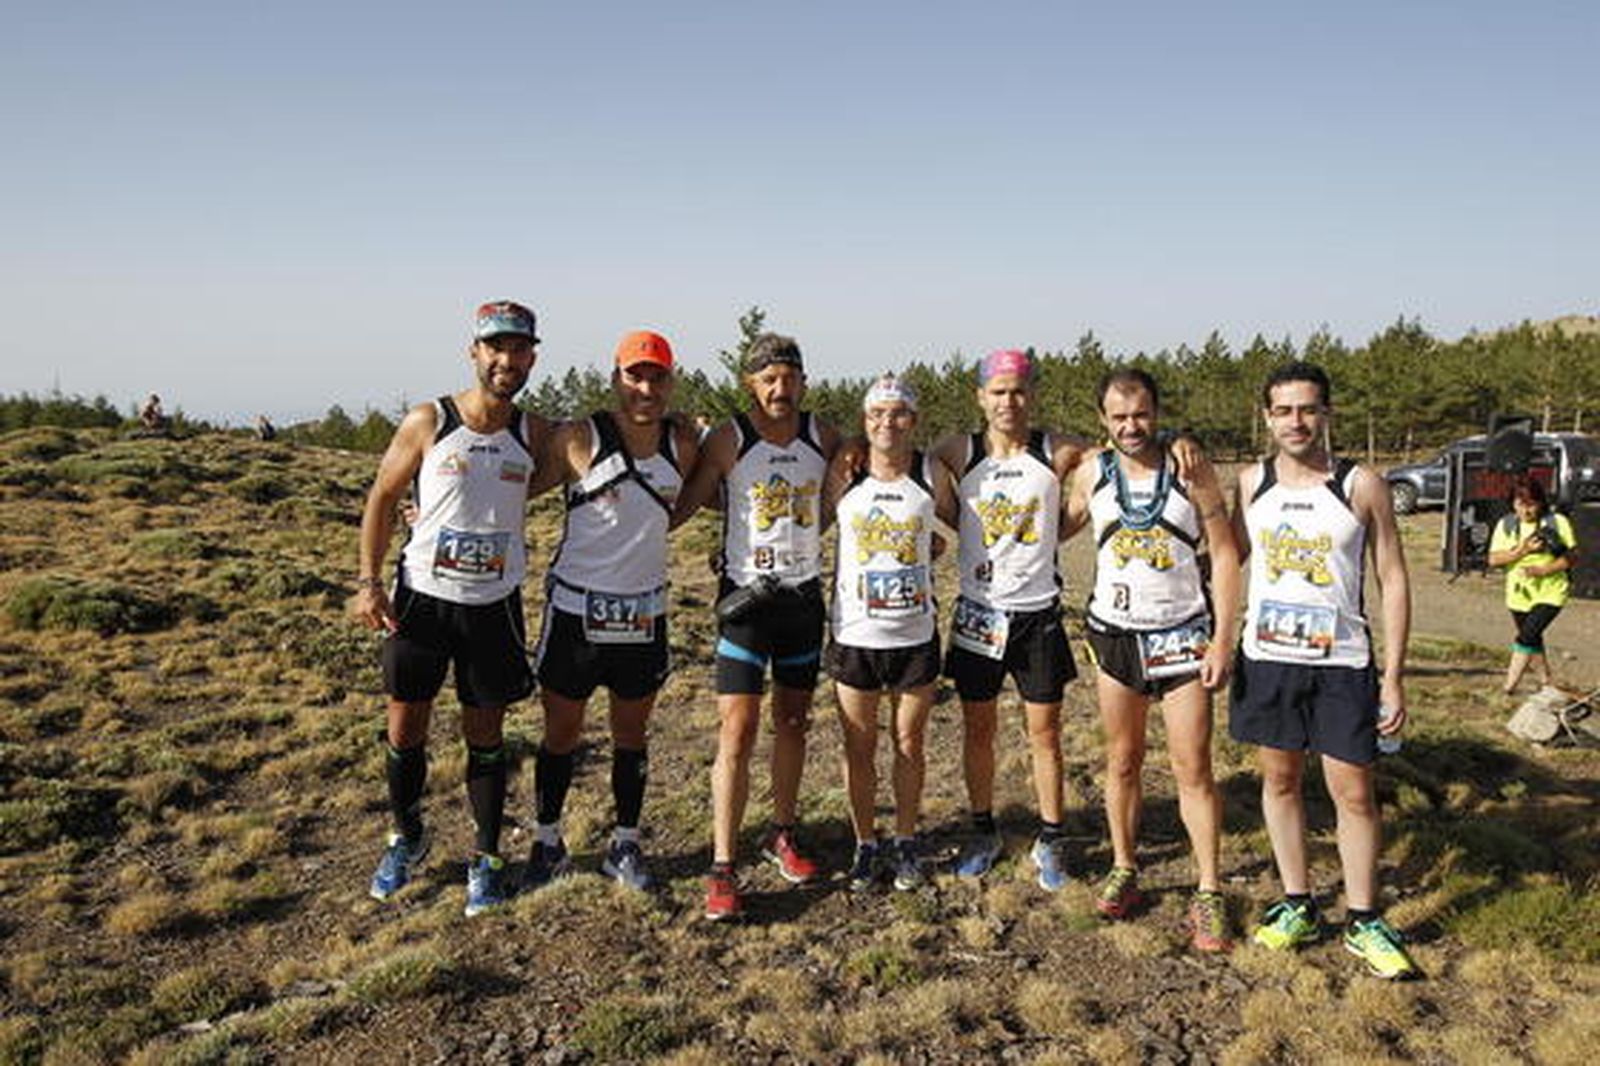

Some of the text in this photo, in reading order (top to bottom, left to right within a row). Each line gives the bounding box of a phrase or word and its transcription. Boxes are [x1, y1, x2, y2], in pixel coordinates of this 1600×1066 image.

[442, 535, 496, 562] 129
[874, 576, 918, 598] 125
[592, 599, 639, 623] 317
[1266, 609, 1314, 637] 141
